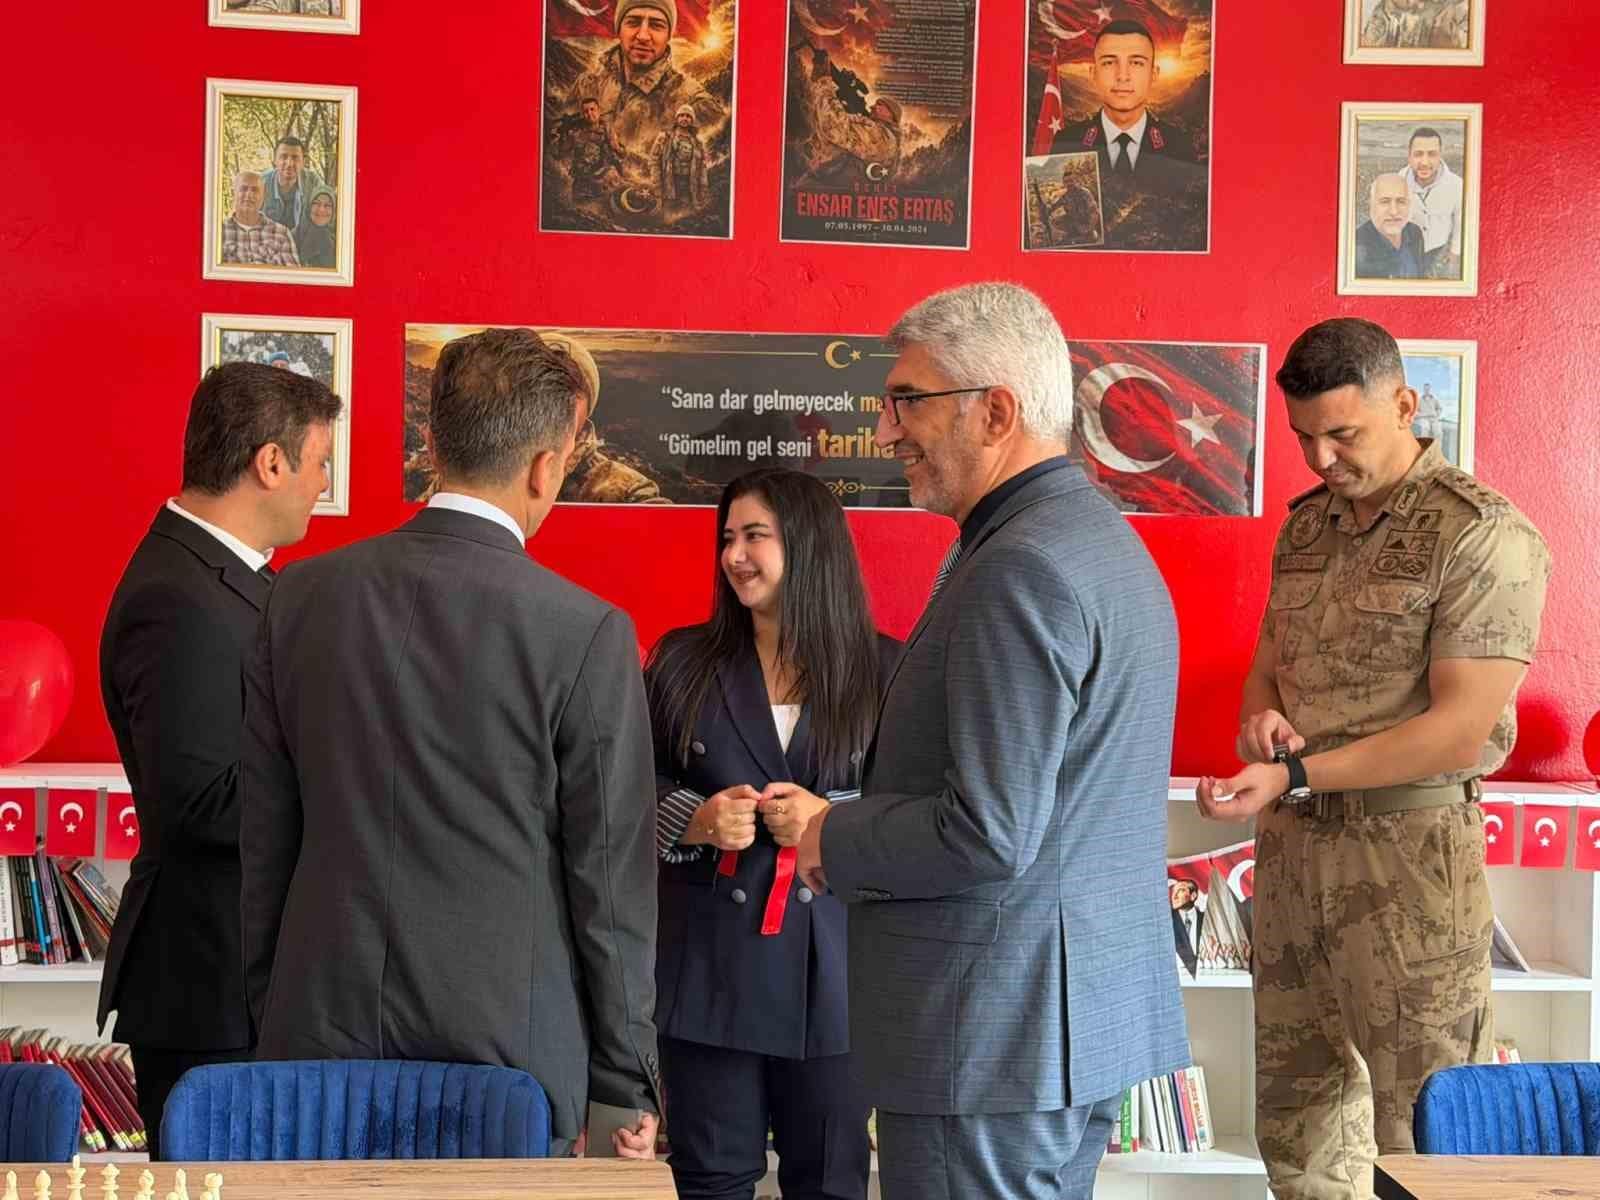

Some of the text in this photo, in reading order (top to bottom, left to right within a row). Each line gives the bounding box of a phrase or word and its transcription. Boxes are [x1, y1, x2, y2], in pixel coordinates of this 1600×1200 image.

[797, 191, 955, 224] ENSAR ENES ERTAŞ
[720, 388, 748, 410] dar
[753, 390, 854, 415] gelmeyecek
[747, 436, 772, 461] gel
[777, 437, 812, 457] seni
